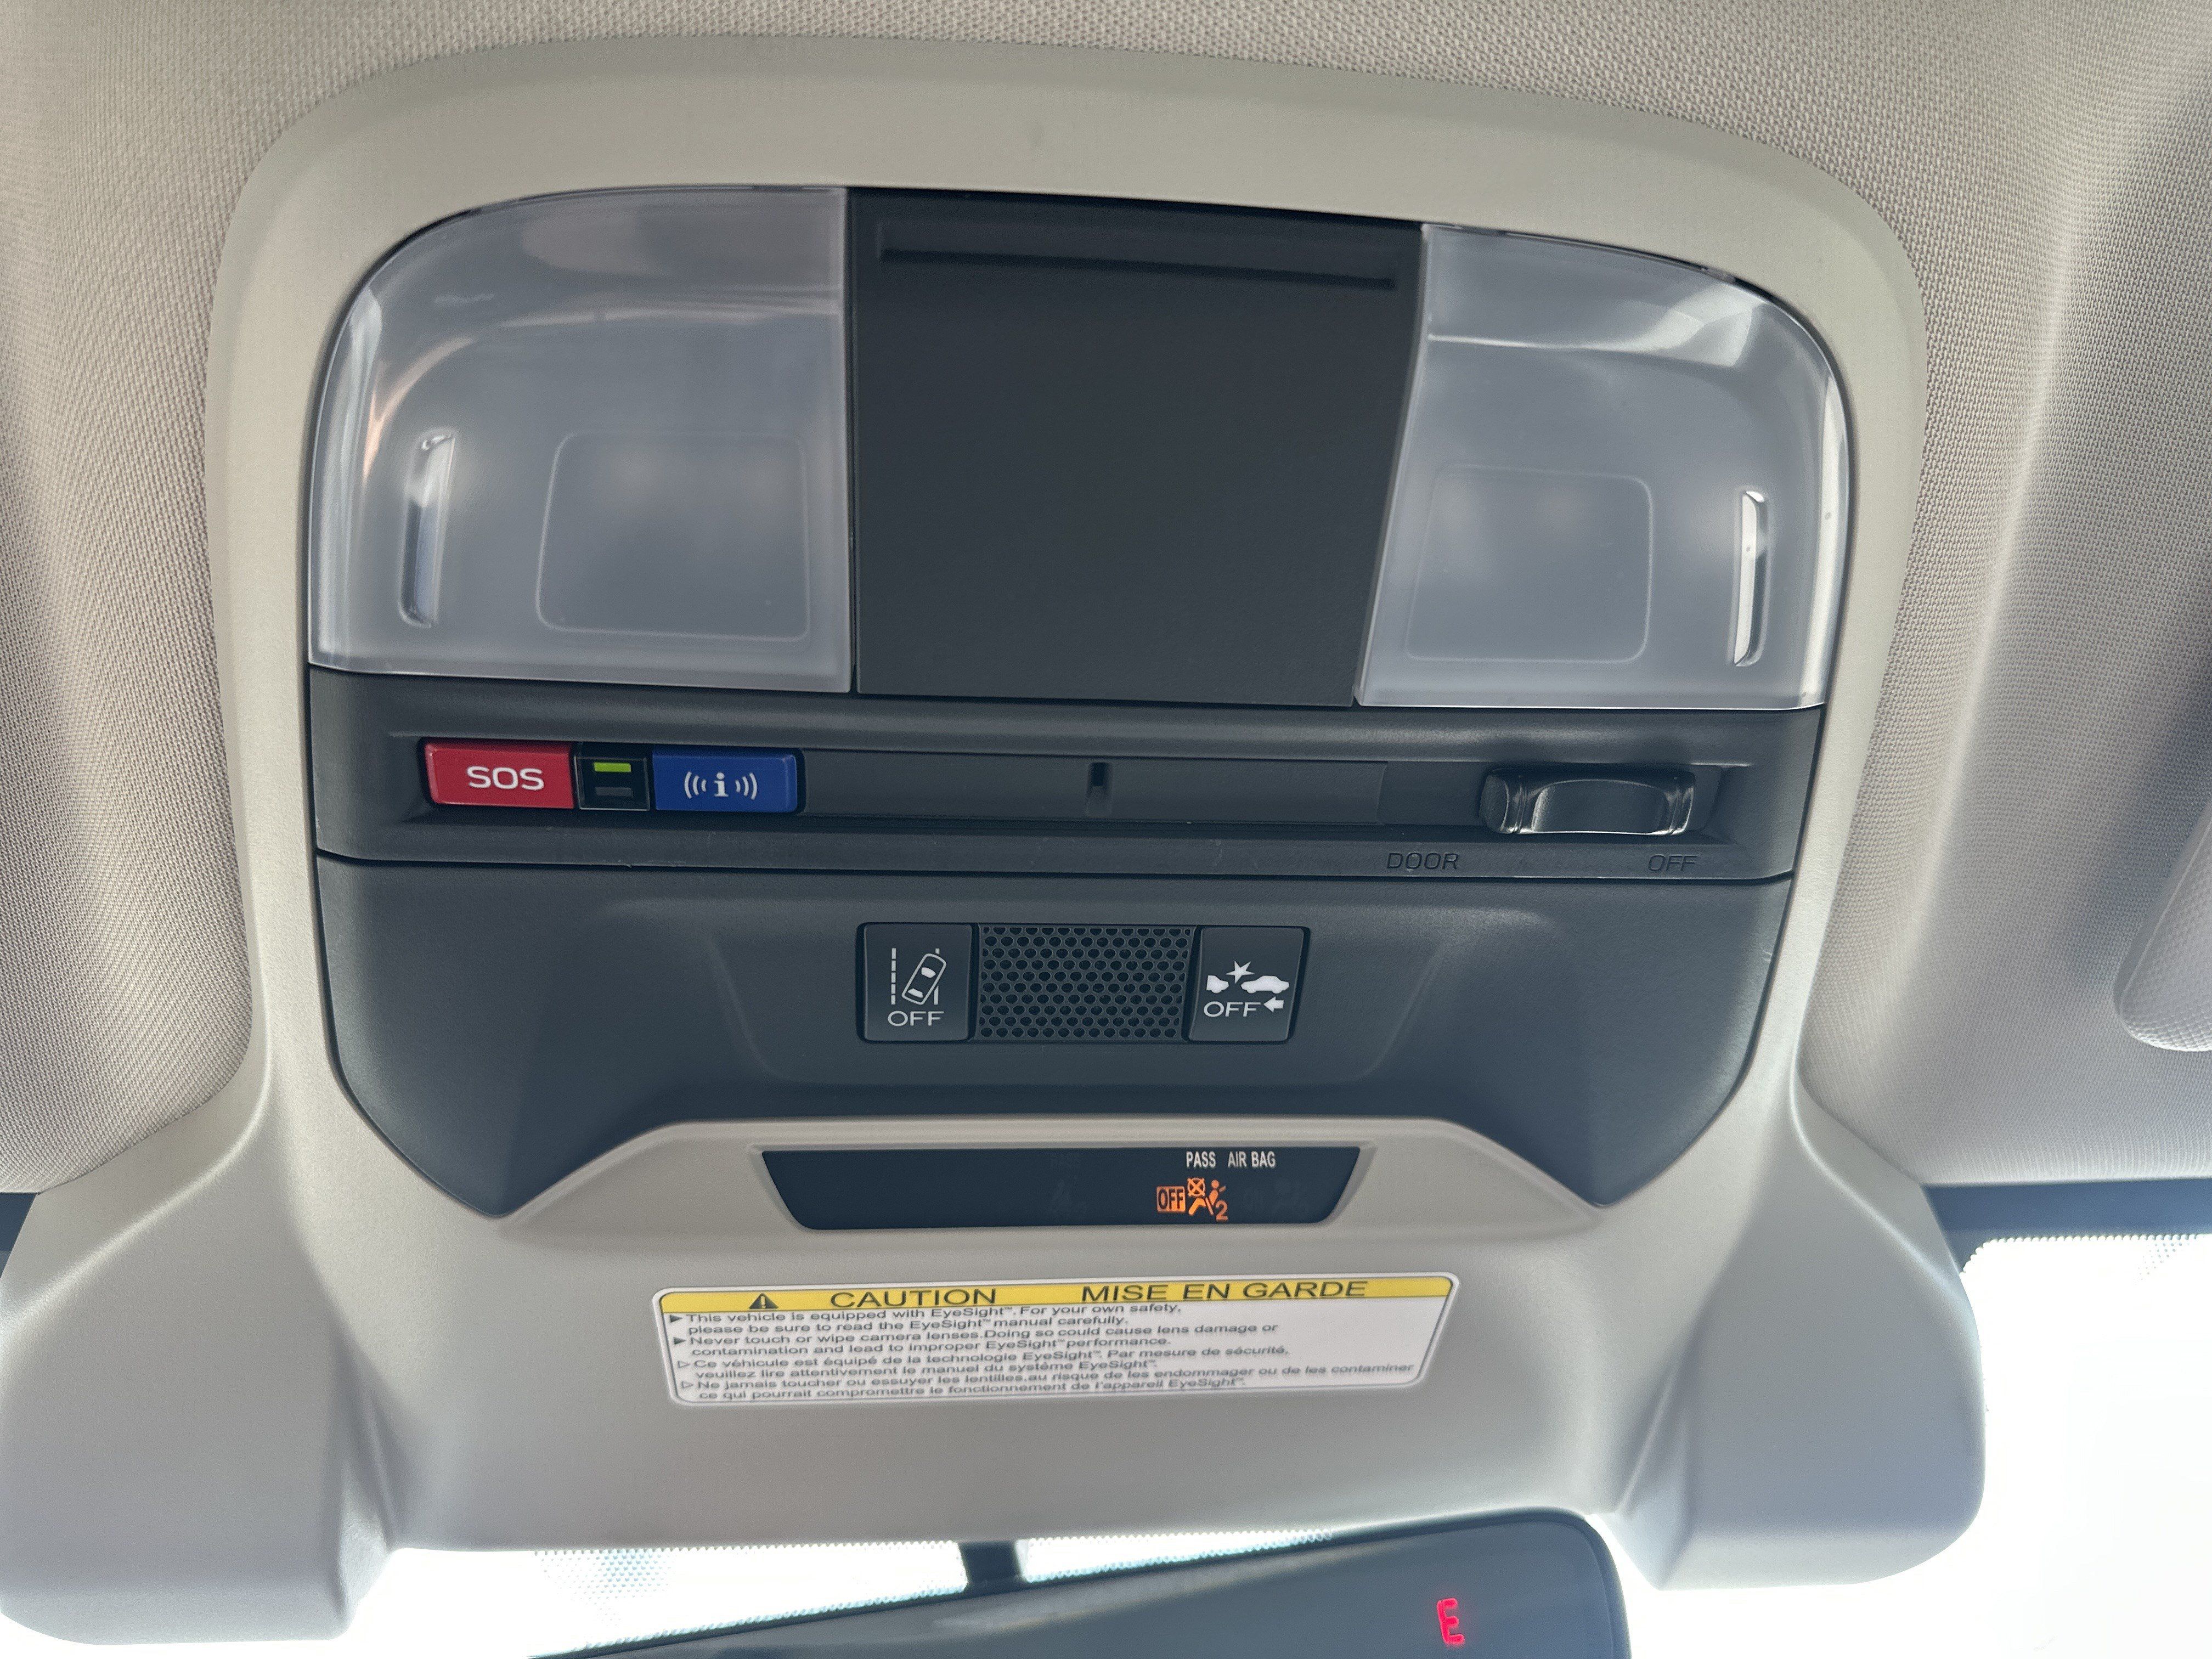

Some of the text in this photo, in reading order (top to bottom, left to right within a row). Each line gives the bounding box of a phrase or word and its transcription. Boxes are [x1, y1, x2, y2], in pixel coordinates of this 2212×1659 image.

[467, 766, 544, 791] SOS
[1386, 852, 1460, 871] DOOR
[1648, 854, 1698, 872] OFF
[887, 1010, 944, 1026] OFF
[1203, 1001, 1261, 1018] OFF
[1186, 1151, 1276, 1168] PASS AIR BAG
[1158, 1189, 1184, 1210] OFF
[831, 1289, 996, 1307] CAUTION
[1081, 1282, 1367, 1301] MISE EN GARDE
[686, 1313, 722, 1323] This
[727, 1312, 786, 1322] vehicle
[792, 1312, 804, 1321] is
[810, 1311, 886, 1320] equipped
[893, 1310, 925, 1318] with
[1020, 1306, 1048, 1315] For
[1052, 1307, 1087, 1316] your
[1130, 1304, 1181, 1313] safety,
[689, 1324, 743, 1335] please
[749, 1324, 769, 1333] be
[816, 1323, 831, 1331] to
[837, 1322, 873, 1330] read
[994, 1317, 1052, 1327] manual
[1058, 1316, 1128, 1325] carefully.
[690, 1336, 740, 1345] Never
[817, 1335, 854, 1344] wipe
[1058, 1328, 1100, 1336] could
[1158, 1325, 1189, 1334] lens
[1195, 1324, 1257, 1333] damage
[1262, 1324, 1278, 1332] or
[692, 1346, 808, 1356] contamination
[849, 1344, 883, 1352] lead
[910, 1342, 980, 1352] improper
[694, 1359, 716, 1368] Ce
[723, 1358, 789, 1368] véhicule
[794, 1358, 819, 1366] est
[823, 1357, 877, 1369] équipé
[883, 1356, 902, 1364] de
[927, 1354, 1017, 1363] technologie
[1108, 1349, 1133, 1358] Par
[1224, 1345, 1289, 1356] sécurité,
[695, 1369, 756, 1378] veuillez
[761, 1369, 785, 1377] lire
[791, 1367, 898, 1377] attentivement
[903, 1365, 916, 1374] le
[922, 1364, 979, 1373] manuel
[1008, 1363, 1073, 1373] système
[698, 1380, 720, 1389] Ne
[725, 1380, 777, 1390] jamais
[782, 1379, 842, 1387] toucher
[871, 1376, 934, 1386] essuyer
[938, 1375, 960, 1384] les
[1052, 1372, 1099, 1381] risque
[1104, 1371, 1122, 1379] de
[1128, 1370, 1149, 1378] les
[1154, 1368, 1254, 1378] endommager
[1282, 1367, 1300, 1375] de
[1305, 1366, 1327, 1374] les
[1330, 1363, 1414, 1374] contaminer
[699, 1391, 718, 1400] ce
[723, 1390, 747, 1400] qui
[752, 1390, 812, 1400] pourrait
[817, 1387, 926, 1397] compromettre
[948, 1384, 1066, 1394] fonctionnement
[1071, 1381, 1090, 1390] de
[1436, 1598, 1465, 1646] E
